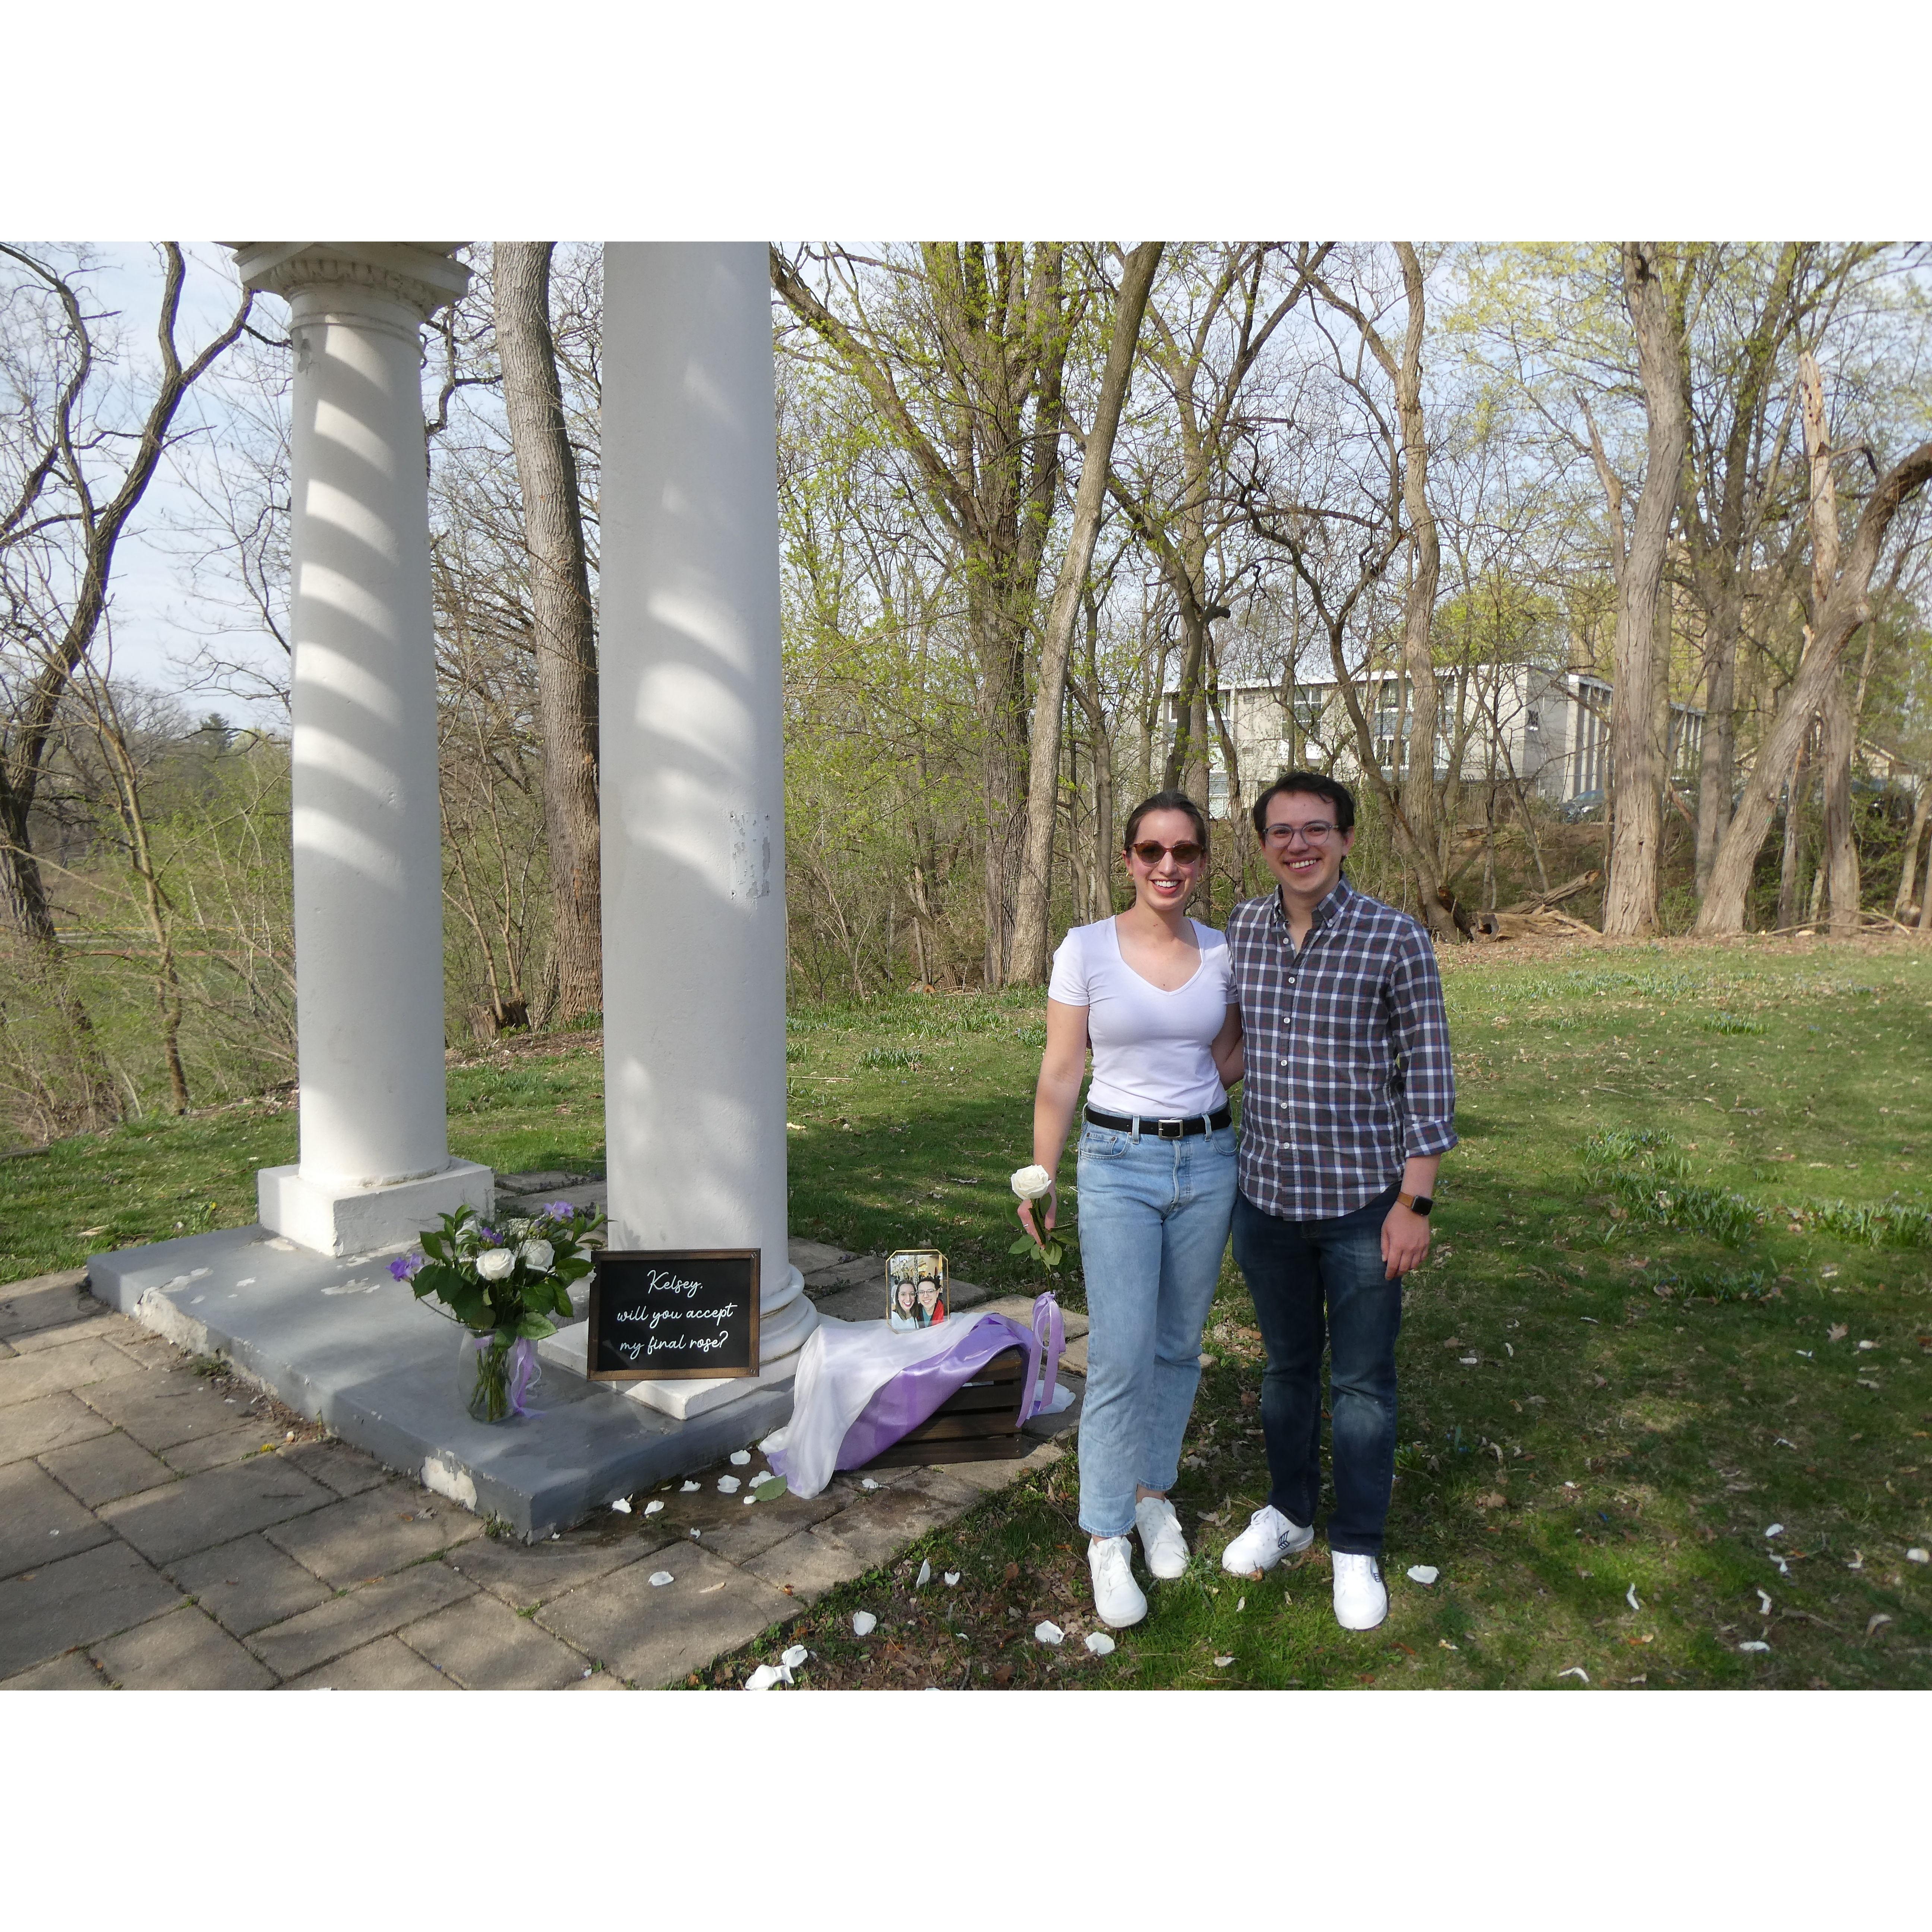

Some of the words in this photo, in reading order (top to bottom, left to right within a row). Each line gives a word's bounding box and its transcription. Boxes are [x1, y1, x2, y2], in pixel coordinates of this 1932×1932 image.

[617, 1306, 649, 1322] will
[649, 1310, 683, 1329] you
[686, 1302, 738, 1326] accept
[620, 1342, 645, 1360] my
[647, 1334, 686, 1355] final
[689, 1330, 729, 1352] rose?
